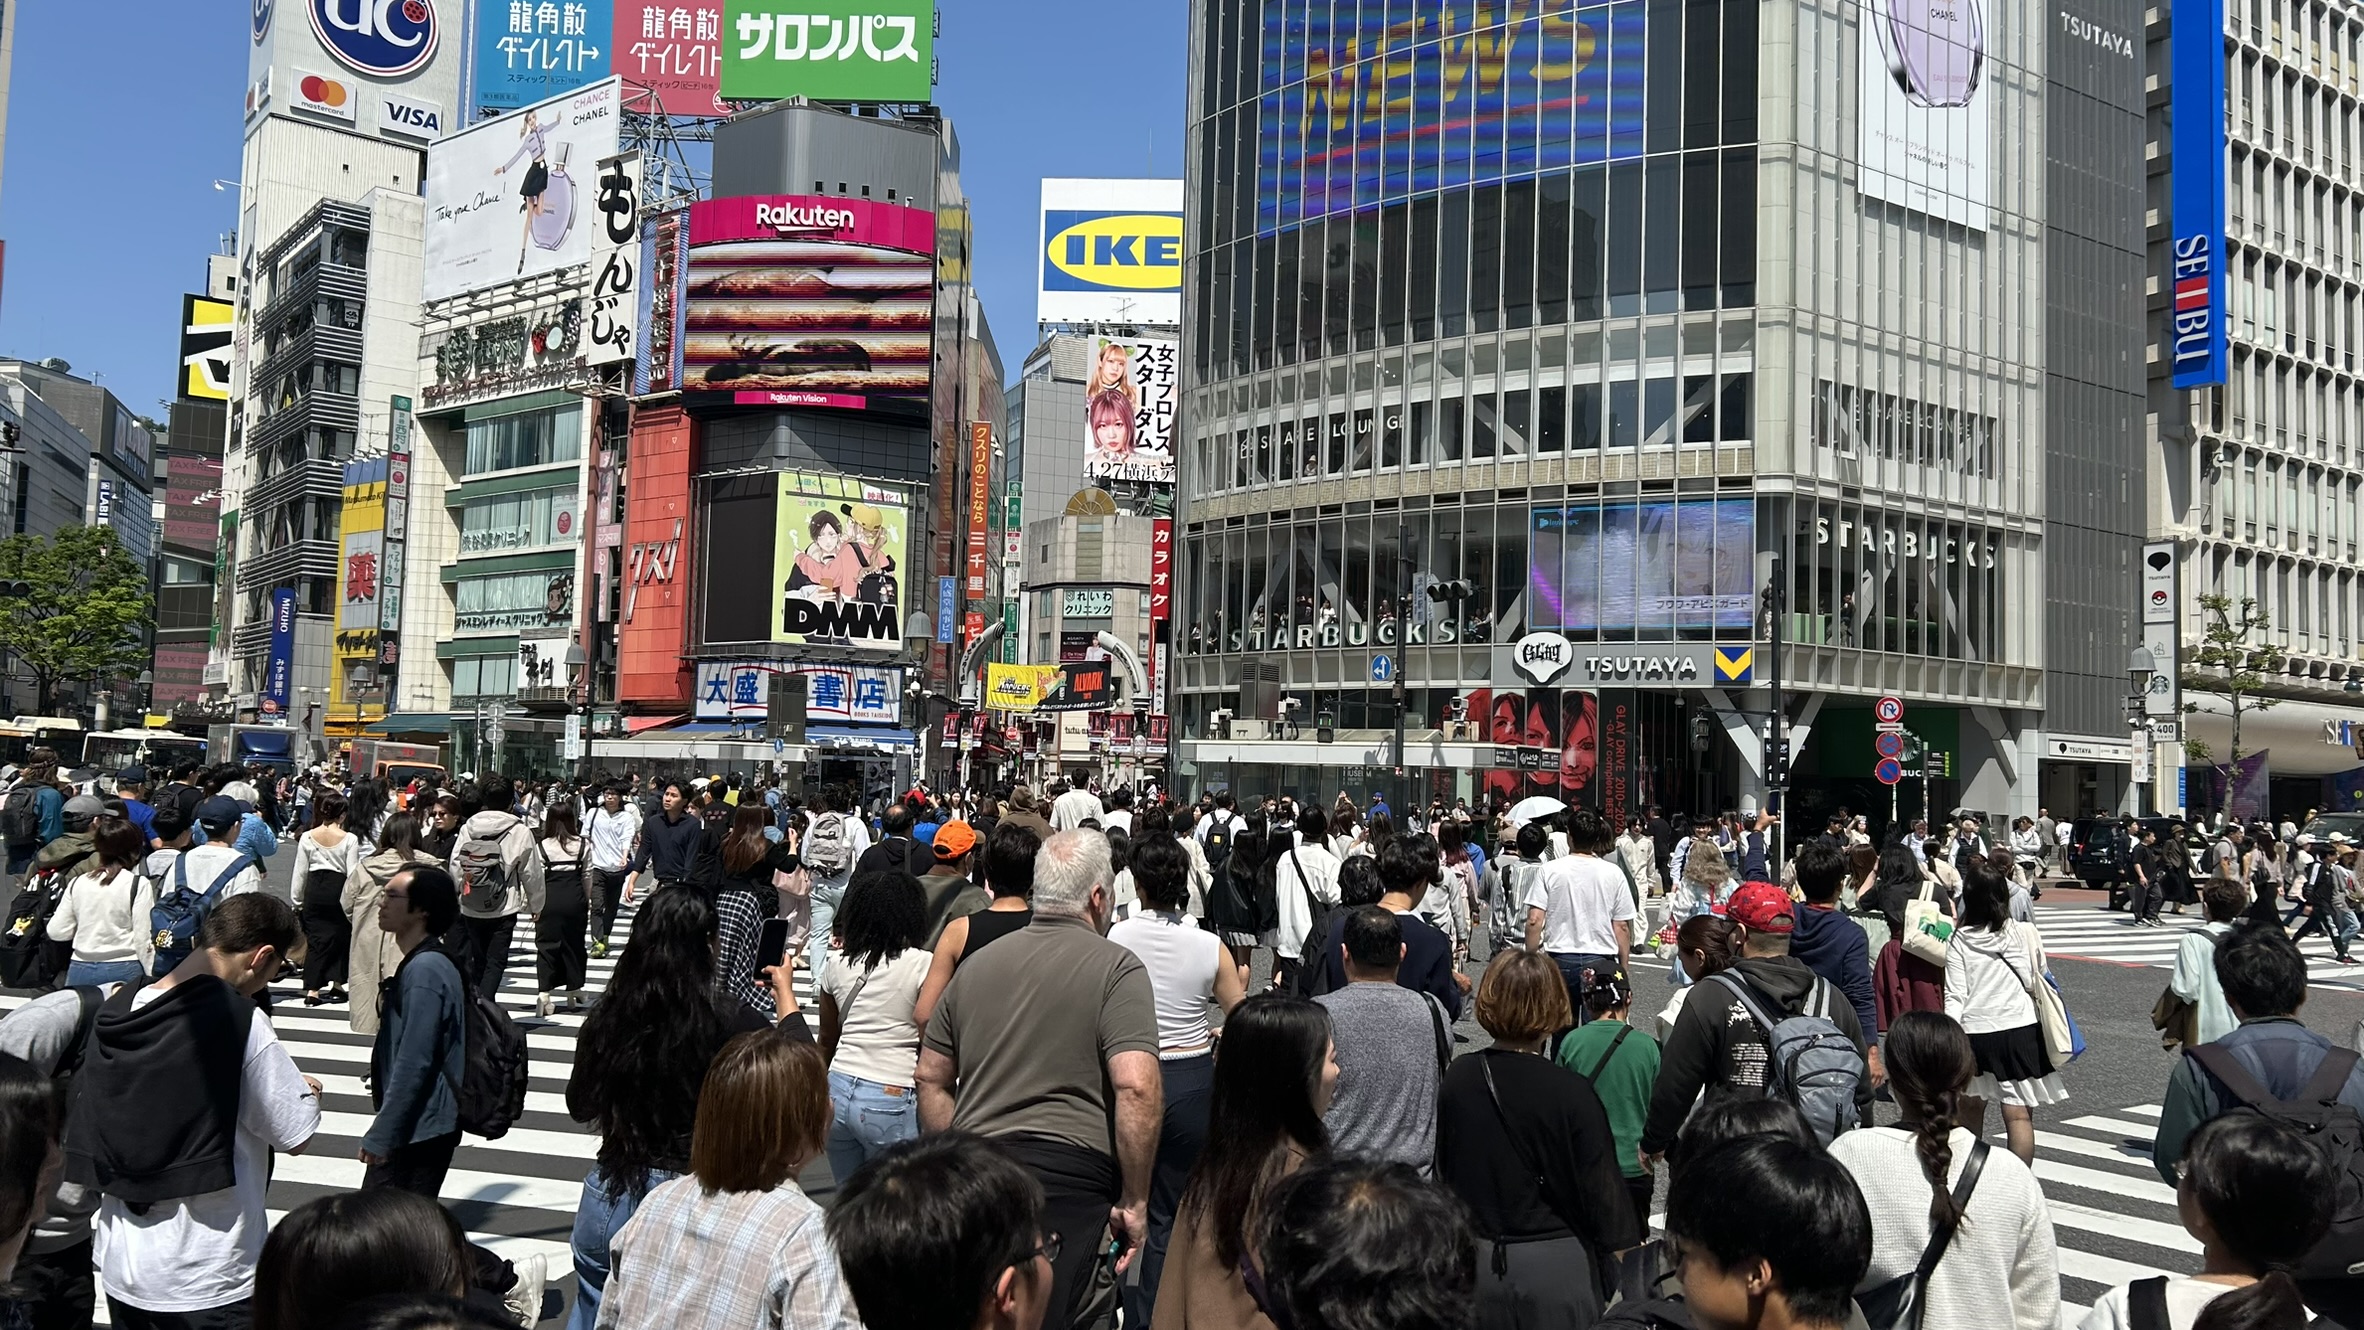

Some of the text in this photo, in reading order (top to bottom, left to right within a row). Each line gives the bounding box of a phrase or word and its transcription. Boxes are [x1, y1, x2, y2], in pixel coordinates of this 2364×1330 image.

[510, 0, 587, 36] 龍角散
[642, 6, 719, 41] 龍角散
[2061, 11, 2133, 59] TSUTAYA
[496, 36, 599, 72] ダイレクト
[736, 13, 918, 63] サロンパス
[630, 41, 722, 77] ダイレクト
[1299, 0, 1596, 134] NEWS
[507, 74, 547, 84] スティック
[641, 79, 680, 89] スティック
[301, 101, 344, 116] mastercard
[384, 101, 438, 131] VISA
[573, 89, 610, 110] CHANCE
[573, 107, 609, 125] CHANEL
[435, 206, 453, 222] Take
[452, 203, 470, 224] your
[756, 202, 855, 230] Rakuten
[591, 159, 636, 355] もんじゃ
[2176, 234, 2209, 364] SEIBU
[770, 393, 827, 404] Rakuten Vision
[1135, 344, 1156, 449] スターダム
[1155, 344, 1175, 451] 女子プロレス
[1261, 427, 1315, 450] SAE
[972, 427, 987, 524] クスリのことなら
[99, 492, 110, 517] LABI
[1817, 517, 1994, 569] STARBUCKS
[346, 551, 377, 603] 薬
[625, 517, 684, 624] クスリ
[968, 531, 985, 591] 三千里
[1151, 529, 1169, 619] カラオケ
[1065, 605, 1112, 614] クリニック
[1077, 591, 1112, 602] れいわ
[280, 597, 291, 633] MIZUHO
[783, 598, 900, 641] DMM
[1231, 618, 1457, 652] STARBUCKS
[1073, 671, 1103, 692] ALVARK
[1586, 656, 1697, 673] TSUTAYA
[706, 672, 886, 710] 大盛書店
[1616, 704, 1626, 735] GLAY
[2157, 724, 2174, 733] 400
[1616, 739, 1626, 772] DRIVE
[2069, 746, 2092, 754] TSUTAYA
[1605, 797, 1614, 819] BEST
